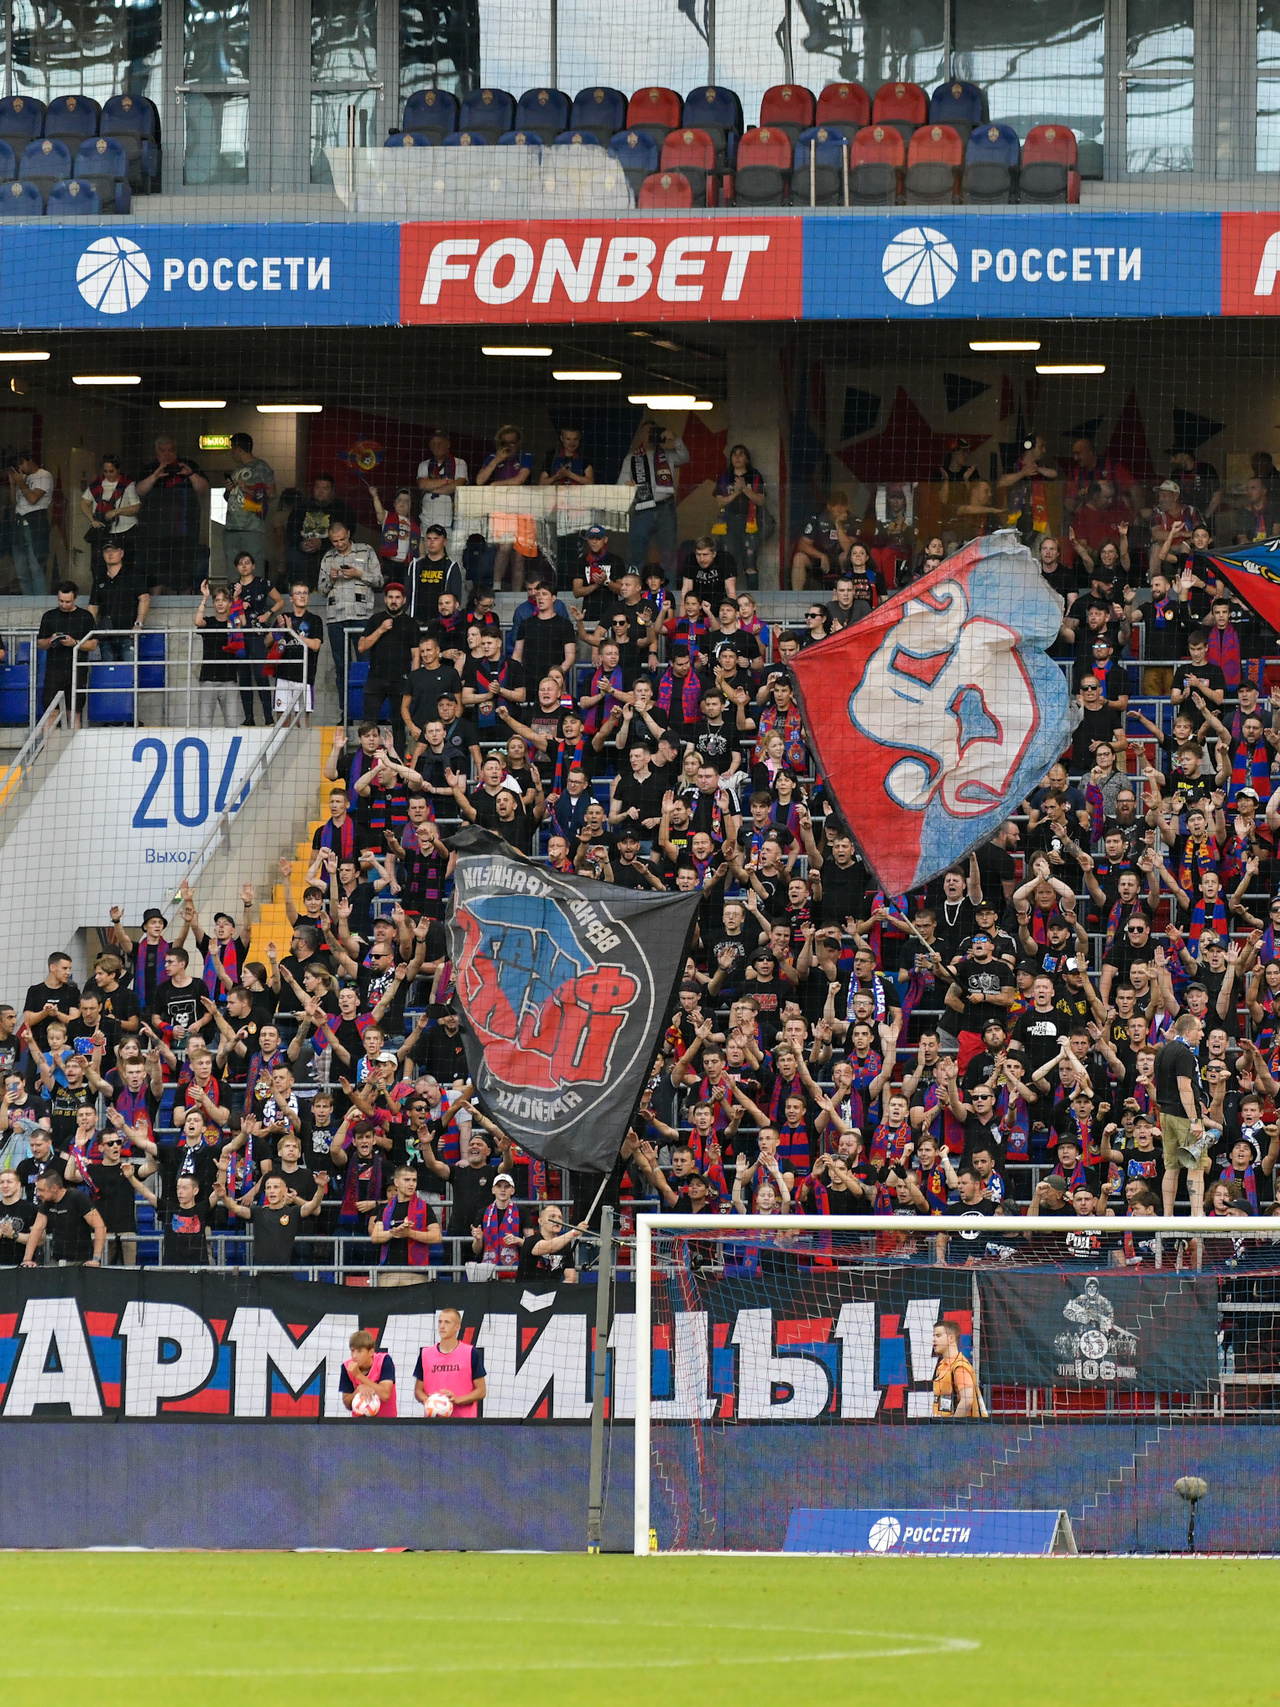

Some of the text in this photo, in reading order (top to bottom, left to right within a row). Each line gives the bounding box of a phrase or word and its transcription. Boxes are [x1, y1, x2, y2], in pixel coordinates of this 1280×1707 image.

[164, 257, 331, 292] РОССЕТИ
[420, 235, 771, 305] FONBET
[971, 247, 1142, 283] РОССЕТИ
[203, 436, 230, 448] ВЫХОД
[132, 736, 251, 829] 204
[903, 1526, 971, 1543] РОССЕТИ
